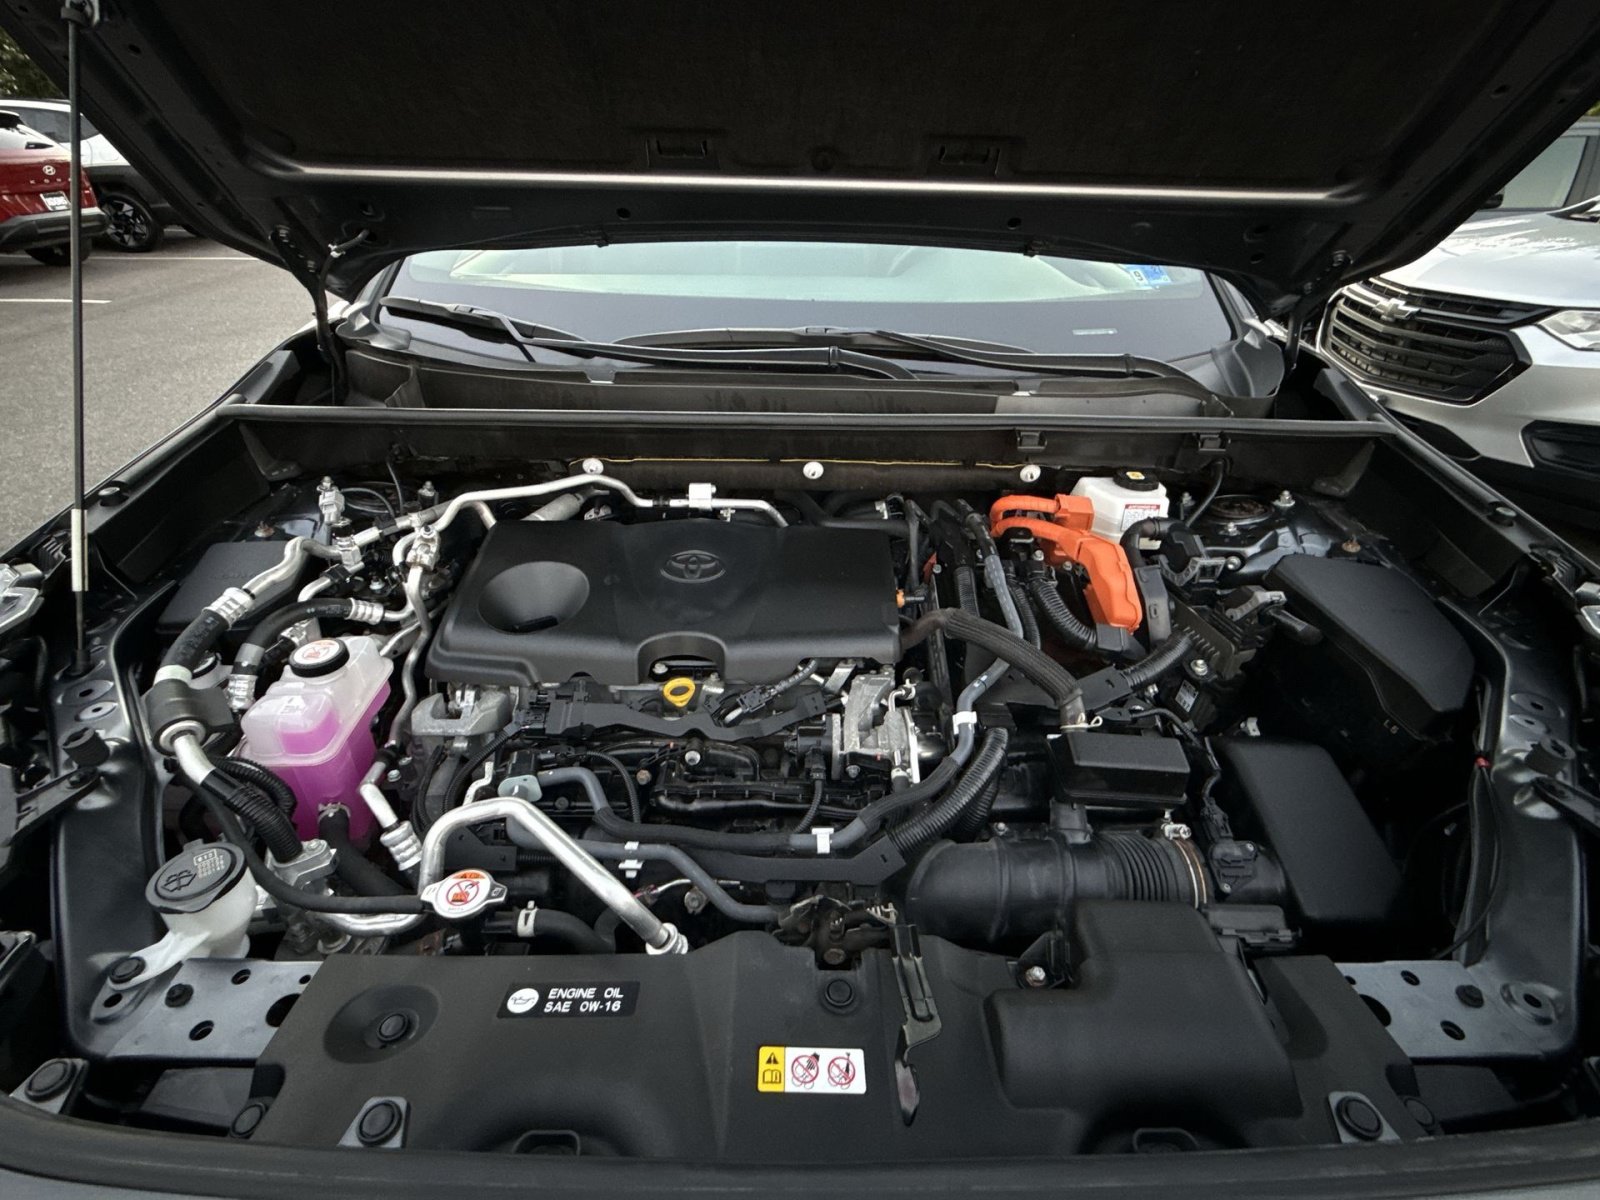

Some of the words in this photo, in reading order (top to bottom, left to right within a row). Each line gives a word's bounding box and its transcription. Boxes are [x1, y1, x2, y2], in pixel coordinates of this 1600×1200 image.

[547, 987, 597, 1000] ENGINE
[603, 987, 625, 999] OIL
[543, 1001, 572, 1013] SAE
[579, 1000, 622, 1012] 0W-16
